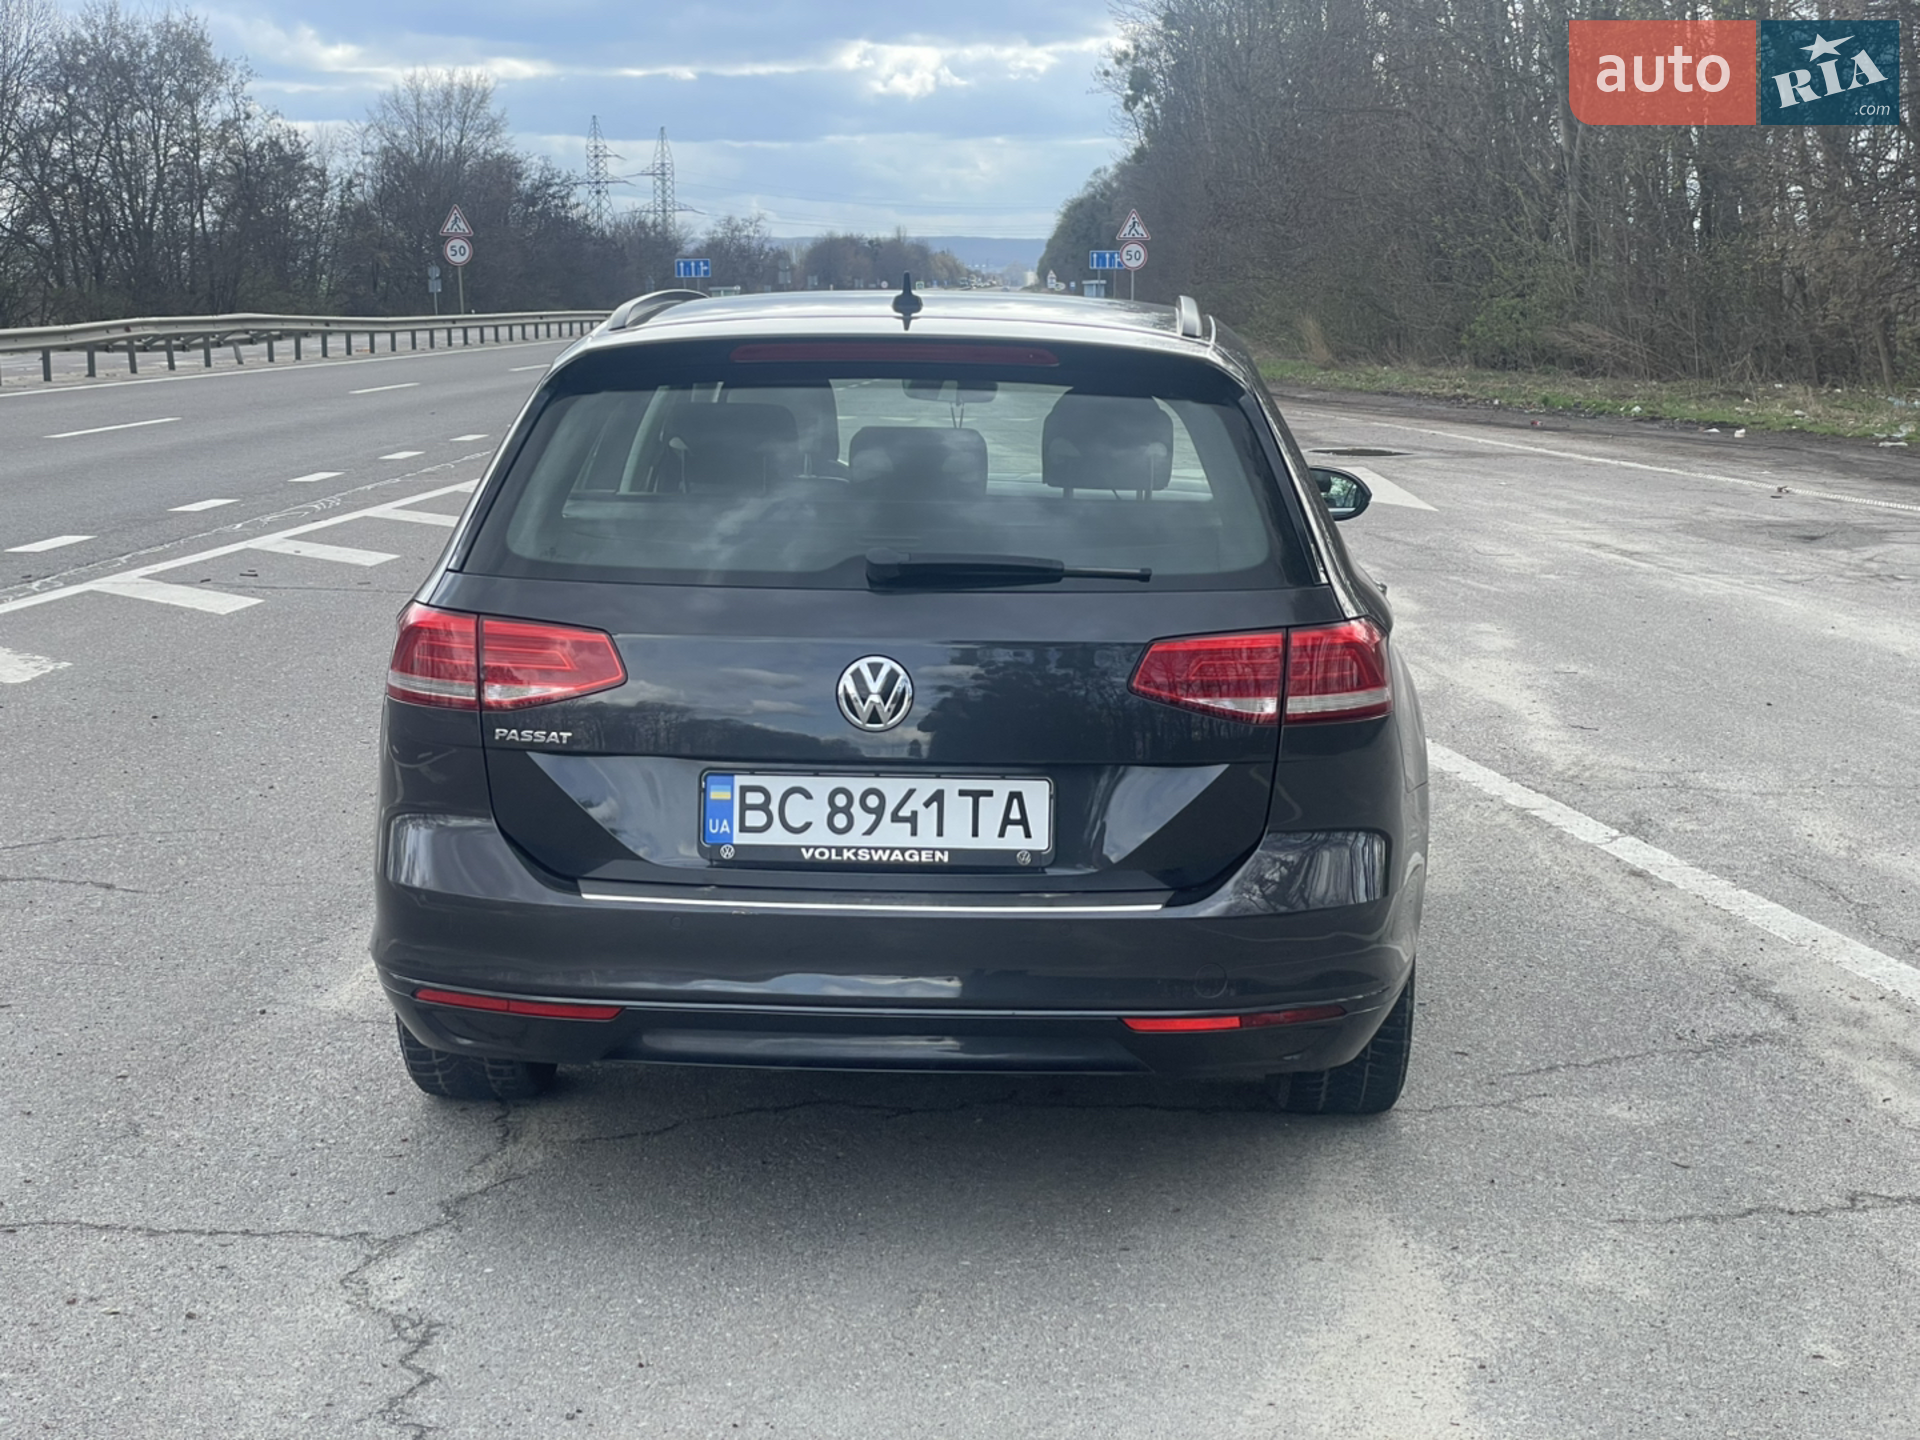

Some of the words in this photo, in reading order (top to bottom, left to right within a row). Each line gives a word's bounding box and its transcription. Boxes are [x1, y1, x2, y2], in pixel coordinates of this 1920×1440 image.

[450, 244, 467, 257] 50
[1125, 250, 1142, 261] 50
[494, 727, 573, 744] PASSAT
[708, 818, 731, 834] UA
[800, 846, 950, 863] VOLKSWAGEN
